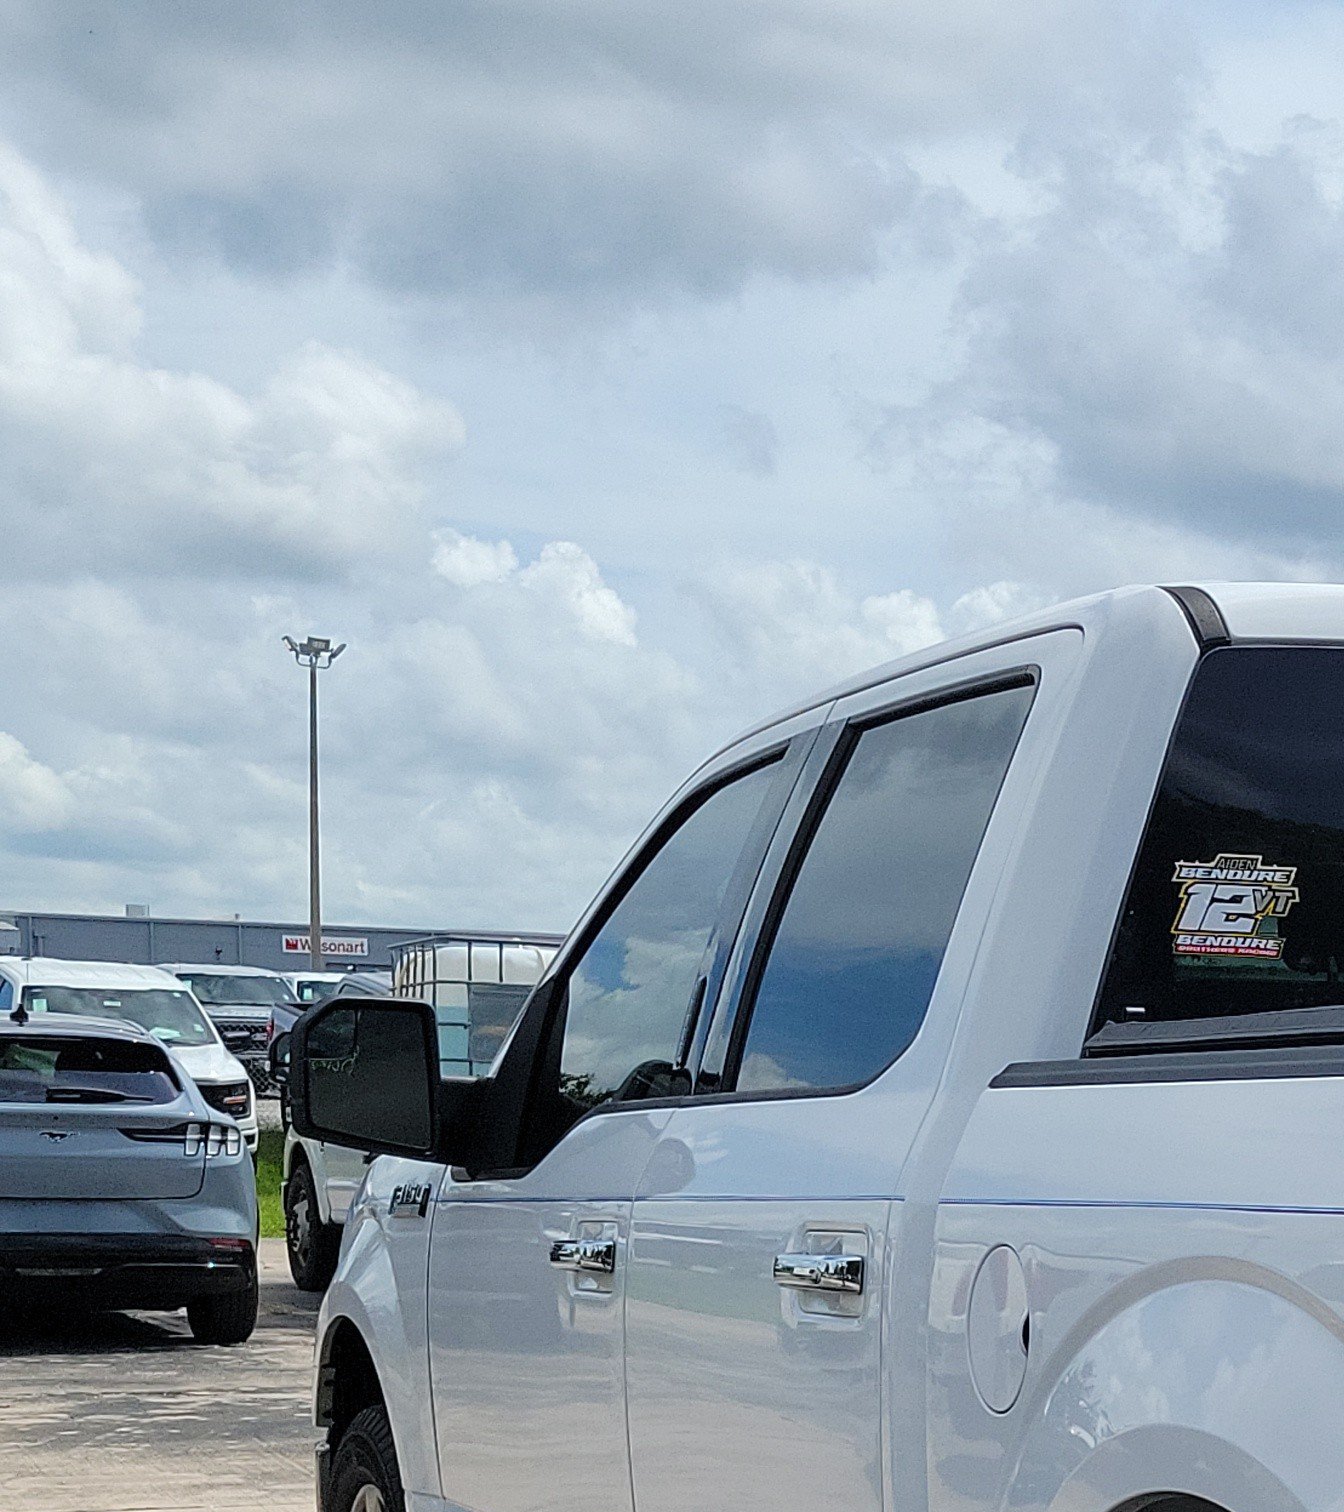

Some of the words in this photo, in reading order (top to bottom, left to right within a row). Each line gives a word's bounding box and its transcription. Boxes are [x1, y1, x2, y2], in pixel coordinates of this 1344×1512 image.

[1217, 858, 1257, 870] AIDEN
[1179, 867, 1290, 882] BENDURE
[300, 938, 365, 954] Wsonart
[1176, 935, 1283, 950] BENDURE
